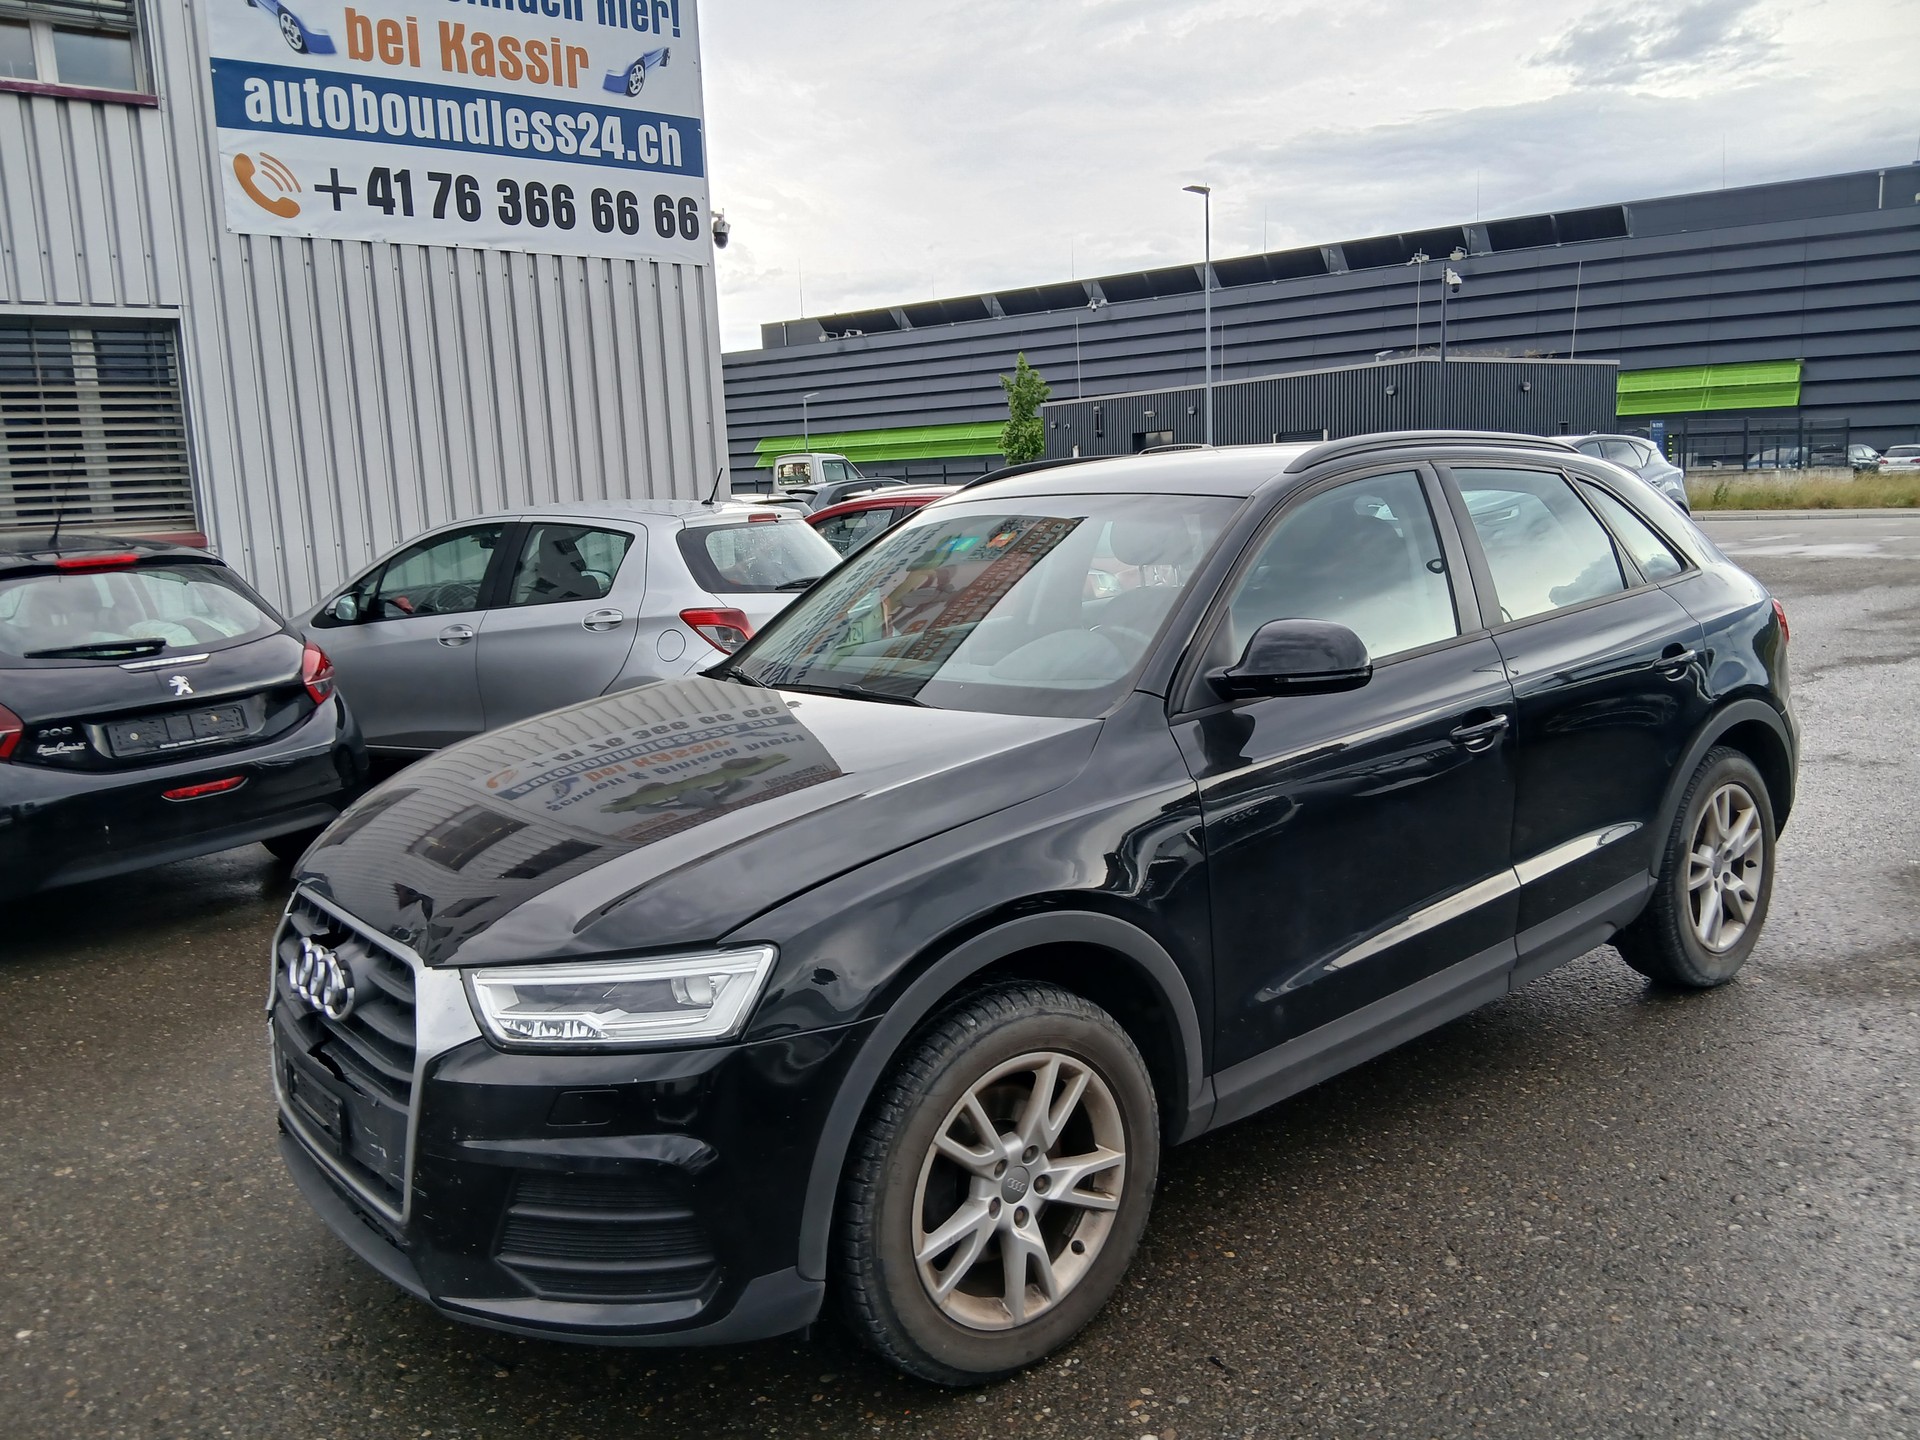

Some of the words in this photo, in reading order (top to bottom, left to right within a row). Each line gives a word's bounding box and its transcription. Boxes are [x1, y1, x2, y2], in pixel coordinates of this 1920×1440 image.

[344, 7, 421, 68] bei
[438, 20, 589, 89] Kassir
[244, 75, 684, 168] autoboundless24.ch
[427, 172, 482, 223] 76
[497, 178, 576, 231] 366
[591, 187, 639, 237] 66
[654, 194, 700, 241] 66
